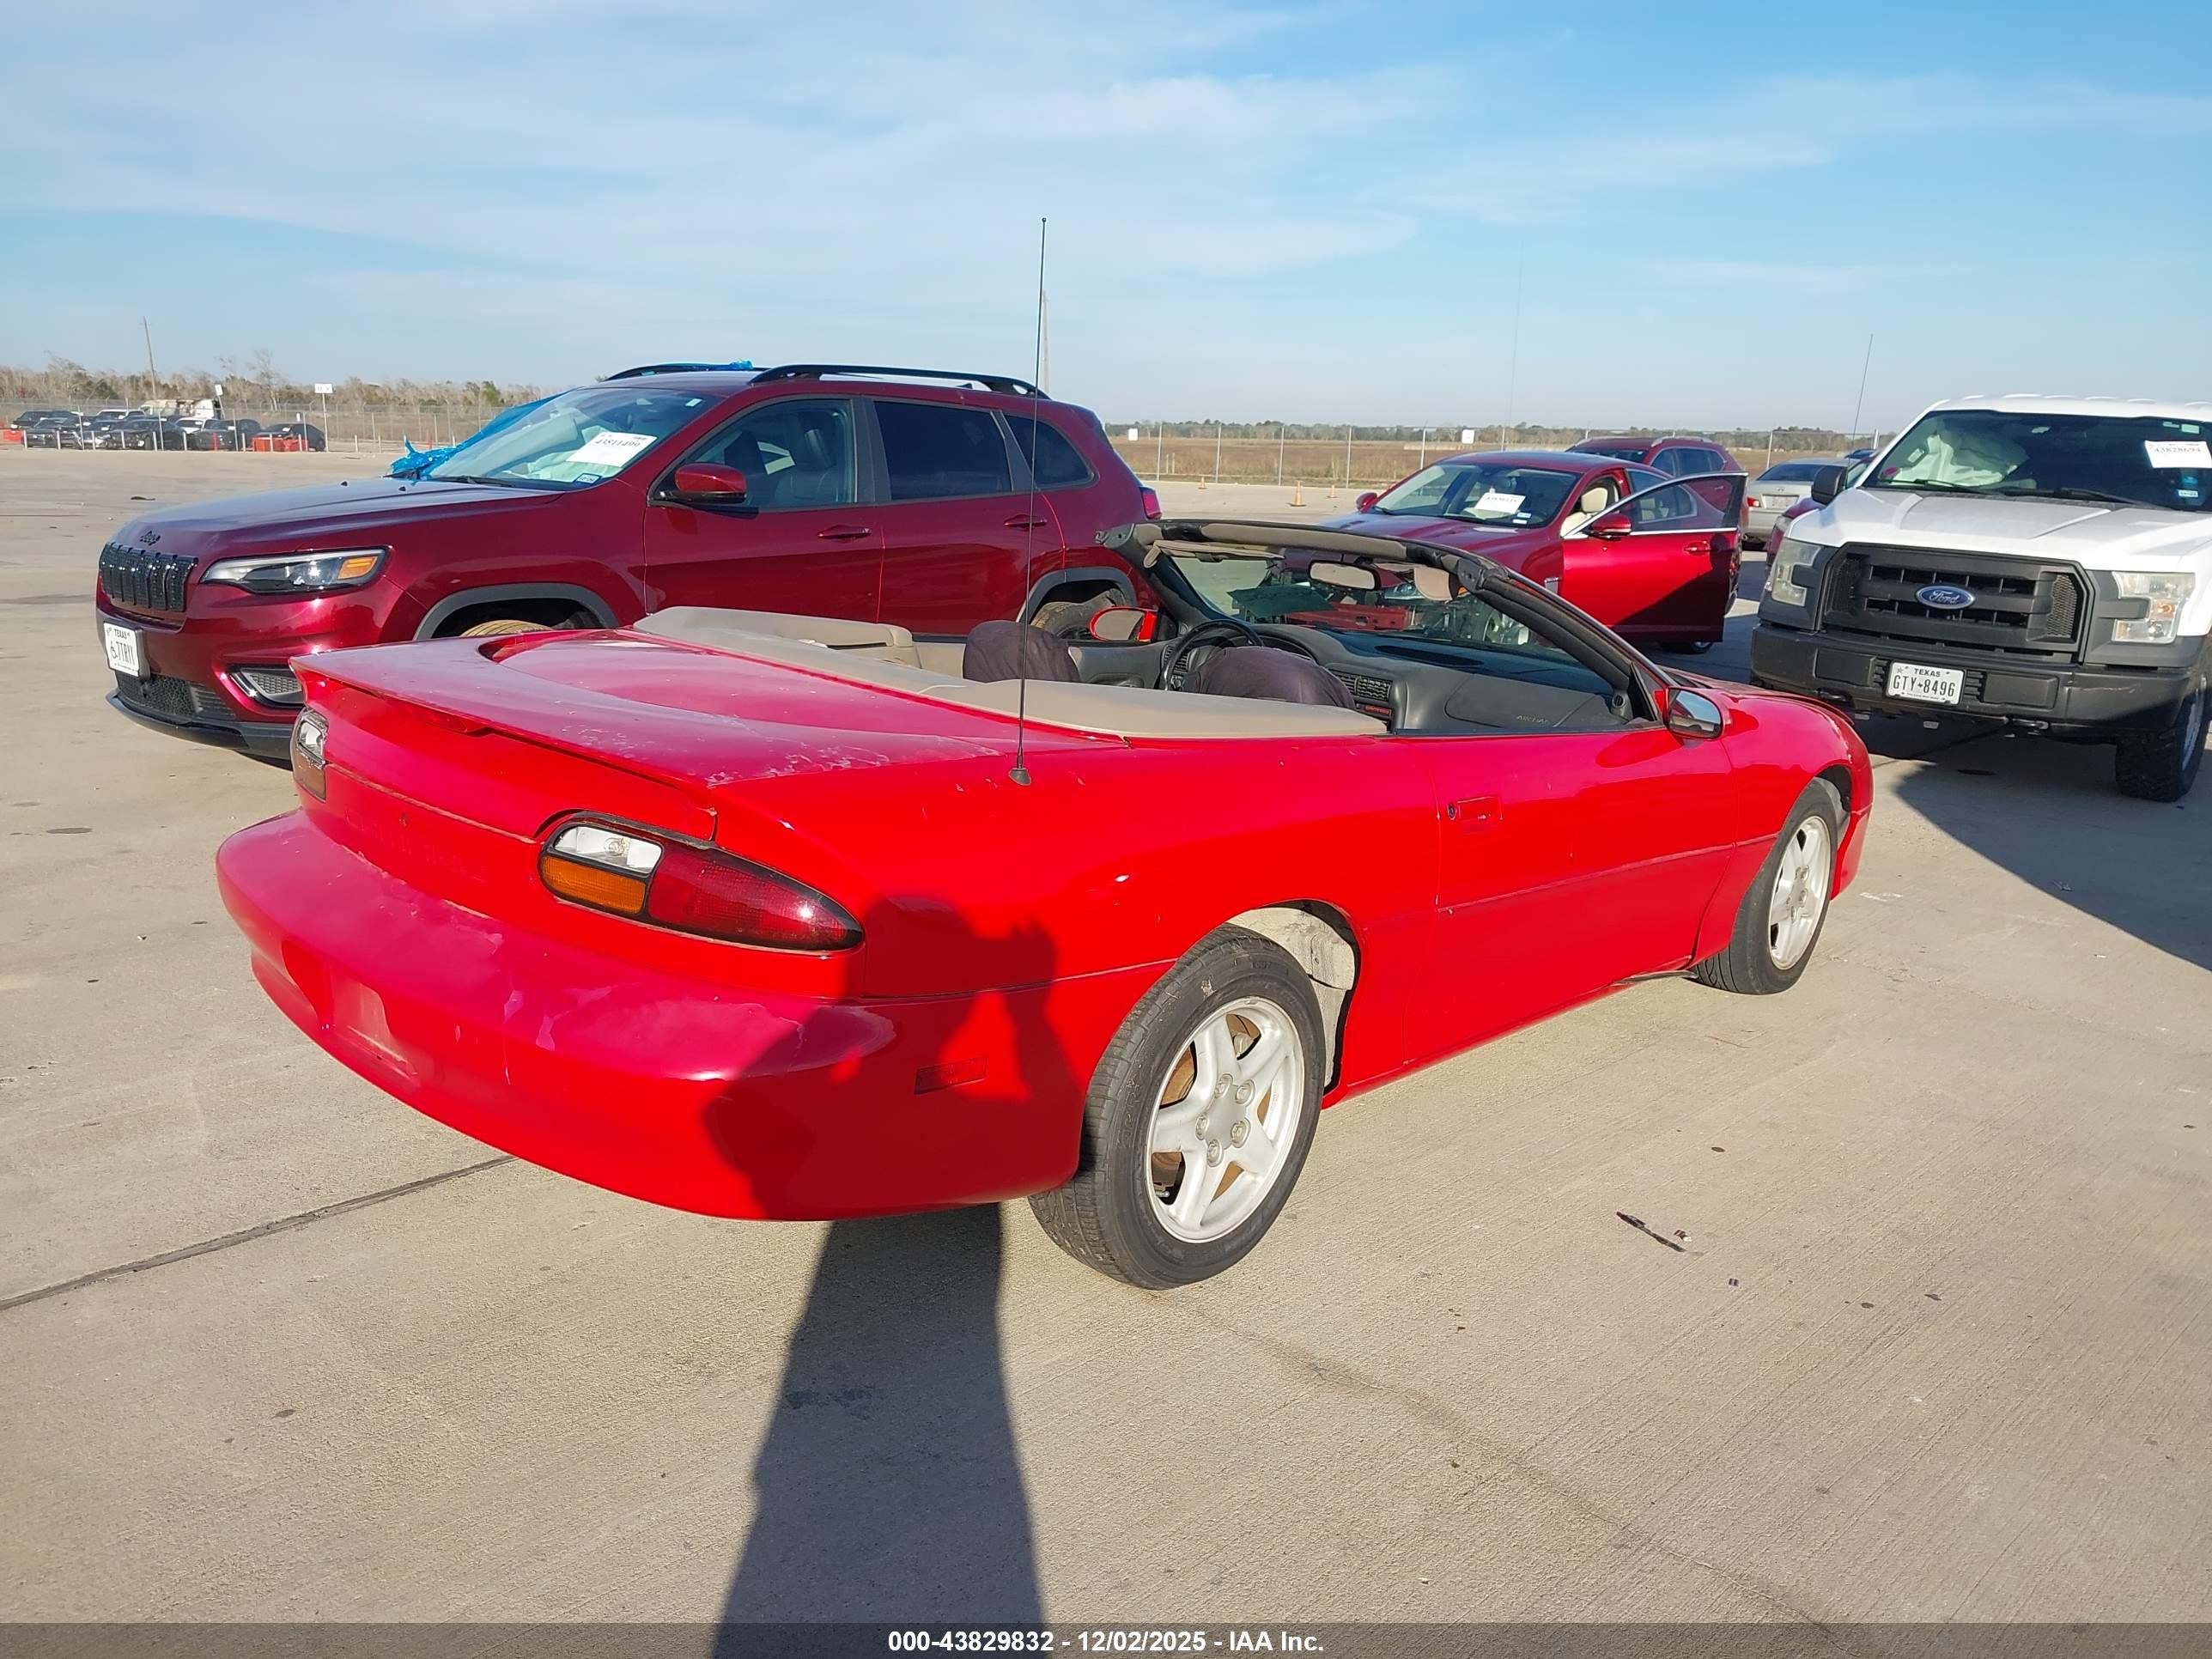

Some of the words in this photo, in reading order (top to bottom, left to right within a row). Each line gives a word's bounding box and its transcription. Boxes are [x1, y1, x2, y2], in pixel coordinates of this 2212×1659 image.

[1929, 591, 1960, 604] Ford
[113, 628, 128, 640] TEXAS
[1914, 668, 1941, 678] TEXAS
